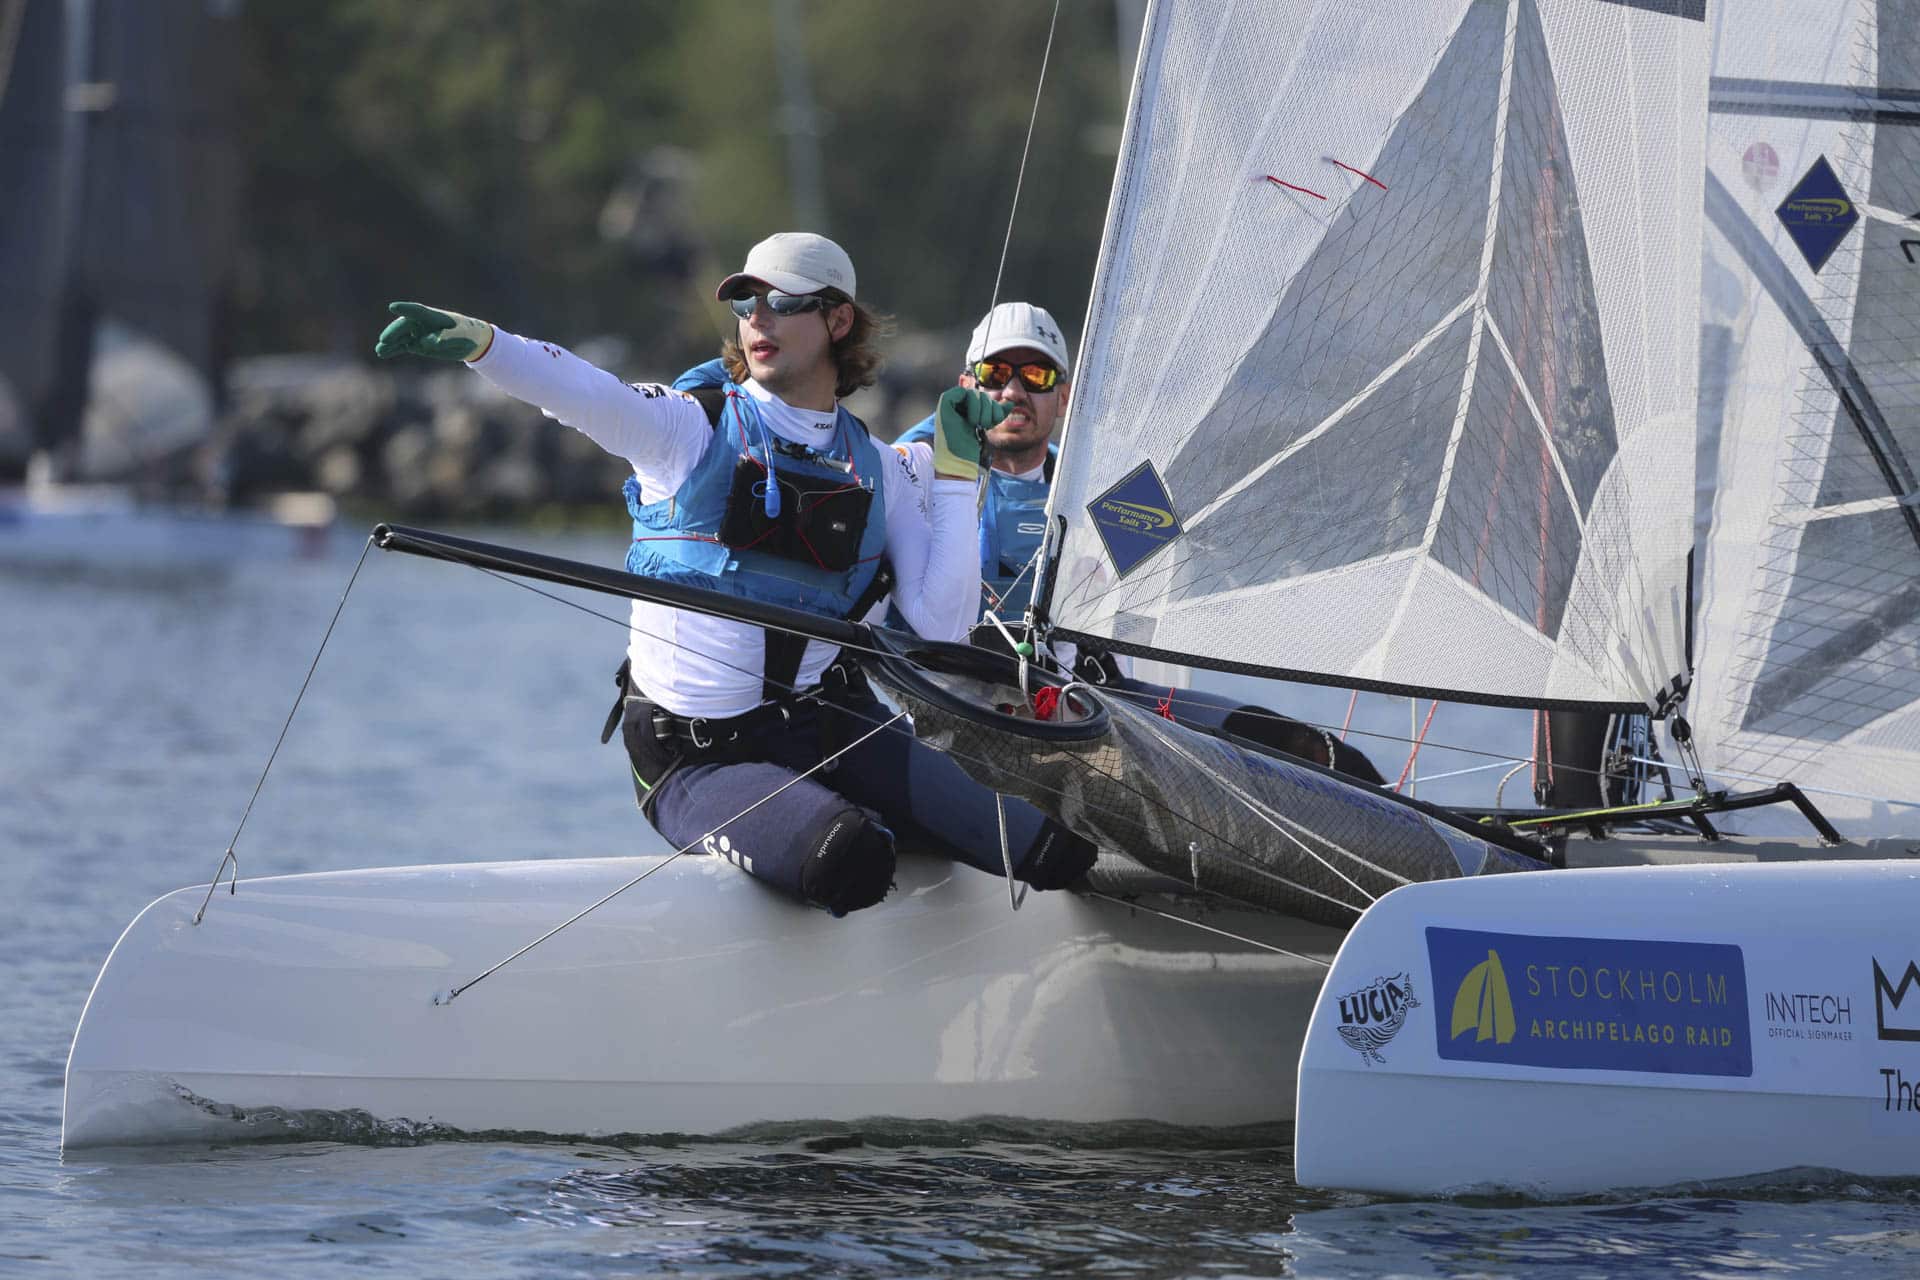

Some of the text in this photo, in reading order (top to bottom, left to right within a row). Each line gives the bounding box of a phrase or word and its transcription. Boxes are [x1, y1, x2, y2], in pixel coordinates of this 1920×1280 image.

[1101, 501, 1161, 524] Performance
[1119, 515, 1140, 527] Sails
[1527, 965, 1728, 1005] STOCKHOLM
[1339, 981, 1404, 1025] LUCIA
[1765, 992, 1851, 1025] INNTECH
[1530, 1018, 1732, 1047] ARCHIPELAGO RAID
[1768, 1027, 1853, 1041] OFFICIAL SIGNMAKER
